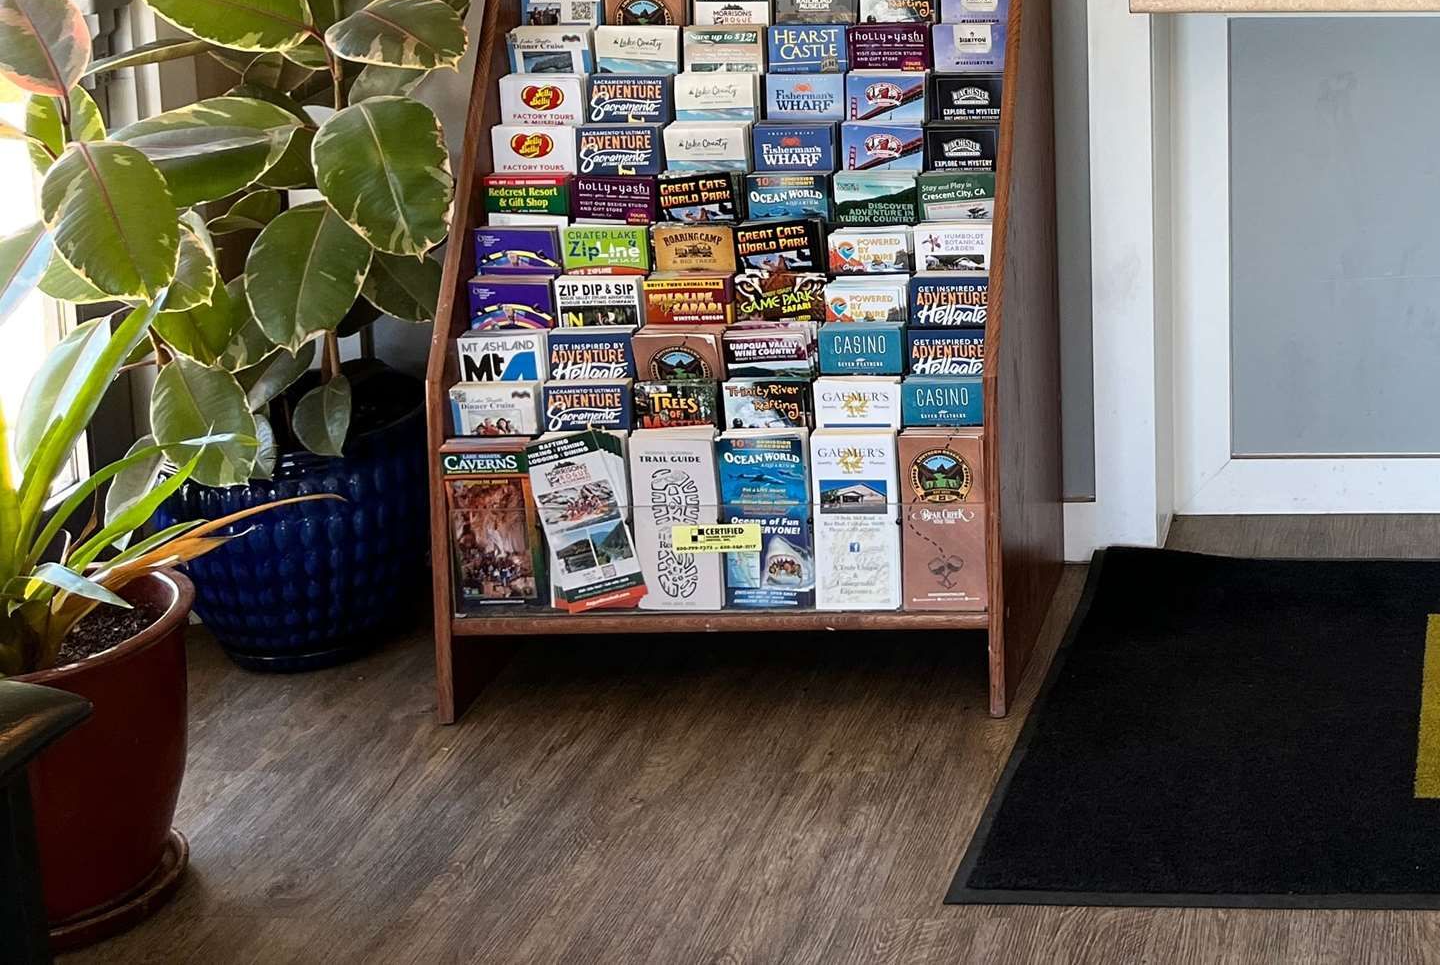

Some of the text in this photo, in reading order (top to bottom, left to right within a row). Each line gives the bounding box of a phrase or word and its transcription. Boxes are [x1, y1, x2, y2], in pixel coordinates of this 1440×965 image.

[888, 0, 933, 17] Rafting
[735, 33, 756, 41] $12!
[774, 30, 838, 44] HEARST
[781, 44, 838, 59] CASTLE
[536, 88, 553, 98] Jelly
[592, 85, 661, 98] ADVENTURE
[776, 90, 833, 99] Fisherman's
[591, 92, 662, 121] Sacramento
[776, 100, 833, 112] WHARF
[526, 135, 542, 146] Jelly
[581, 136, 650, 149] ADVENTURE
[763, 144, 821, 153] Fisherman's
[579, 143, 652, 173] Sacramento
[763, 154, 822, 167] WHARF
[489, 188, 557, 196] Redcrest Resort
[660, 178, 726, 194] GREAT CATS
[660, 192, 730, 206] WORLD PARK
[751, 189, 822, 204] OCEAN WORLD
[922, 192, 955, 200] Crescent
[957, 190, 973, 198] City,
[499, 198, 548, 207] & Gift Shop
[664, 232, 723, 246] ROARING CAMP
[738, 226, 804, 241] GREAT CATS
[738, 237, 808, 255] WORLD PARK
[559, 285, 633, 296] ZIP DIP & SIP
[741, 292, 812, 313] GAME PARK
[917, 292, 987, 304] ADVENTURE
[782, 302, 811, 313] SAFARI
[918, 305, 987, 325] Hellgate
[462, 340, 534, 352] MT ASHLAND
[834, 336, 886, 354] CASINO
[912, 345, 984, 358] ADVENTURE
[552, 349, 624, 362] ADVENTURE
[735, 349, 756, 357] WINE
[725, 385, 798, 398] Trinity River
[917, 388, 968, 406] CASINO
[548, 394, 620, 407] ADVENTURE
[649, 393, 698, 413] TREES
[546, 402, 622, 430] Sacramento
[754, 401, 798, 419] Rafting
[444, 455, 518, 469] CAVERNS
[724, 452, 800, 463] OCEAN WORLD
[770, 517, 779, 525] of
[782, 518, 798, 526] Fun
